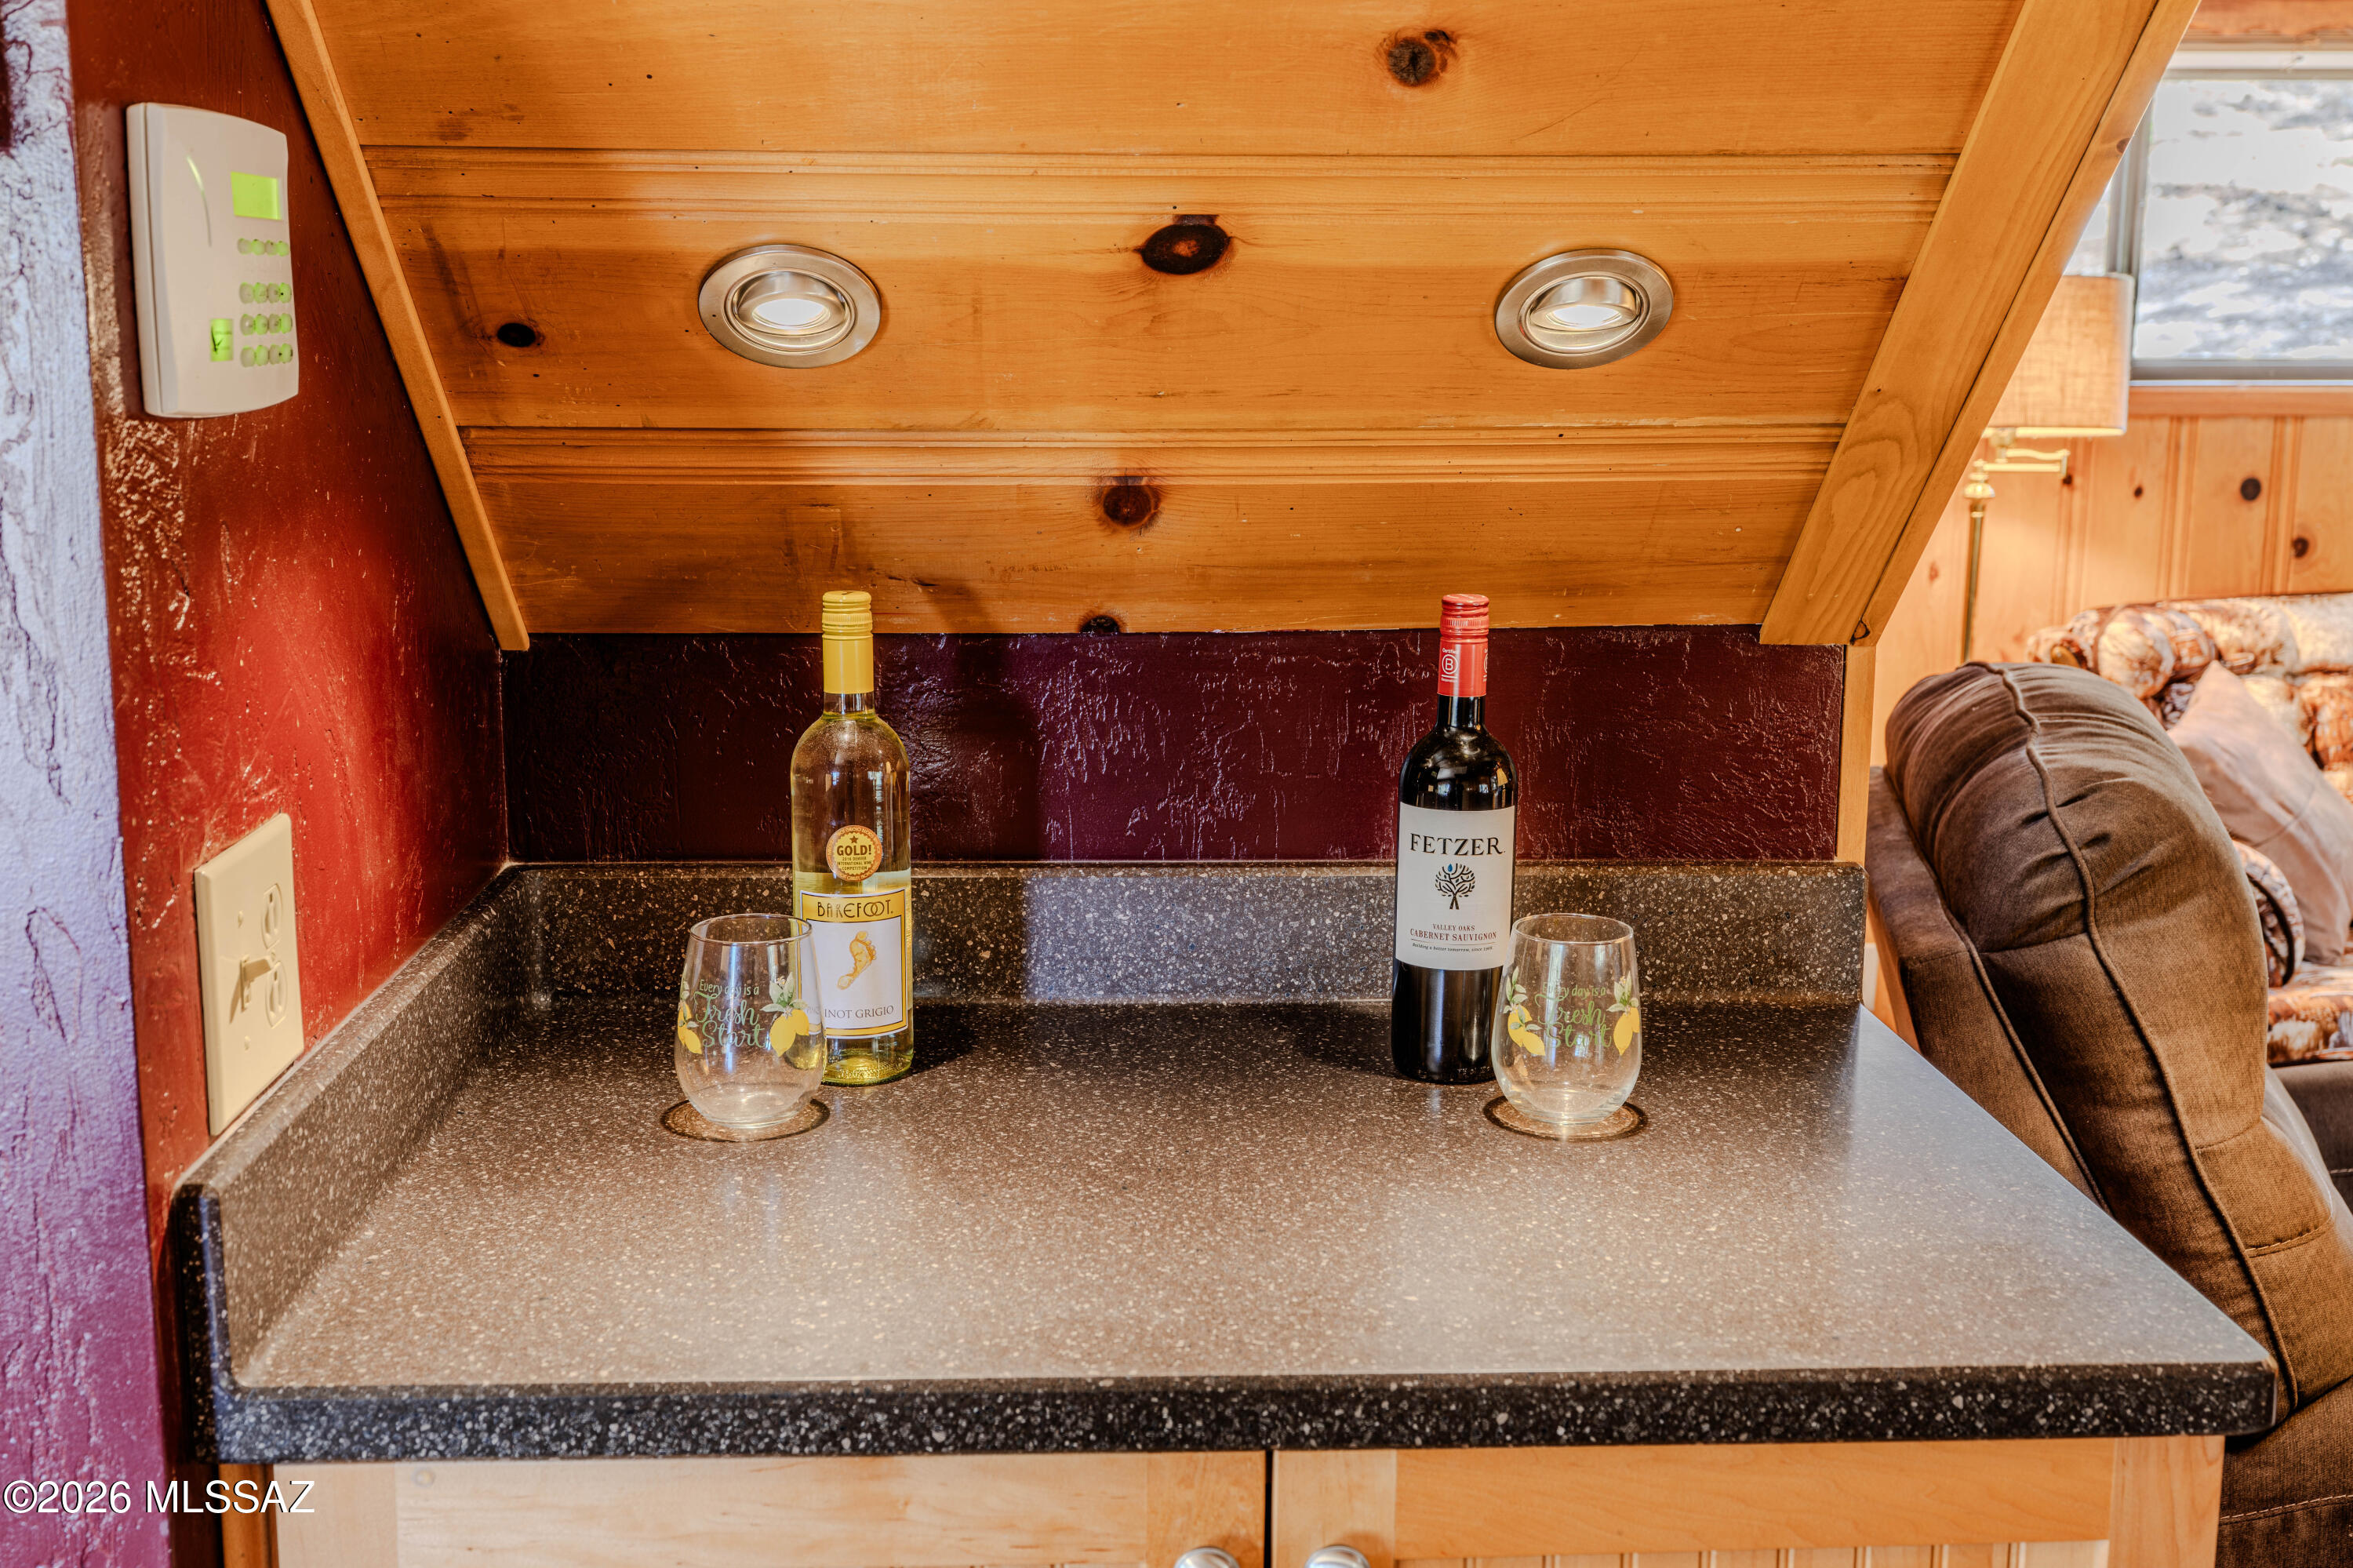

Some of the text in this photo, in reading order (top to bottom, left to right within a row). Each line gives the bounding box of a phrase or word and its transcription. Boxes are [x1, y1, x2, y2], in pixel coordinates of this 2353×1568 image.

[1446, 658, 1453, 671] B
[837, 845, 871, 856] GOLD!
[1410, 833, 1503, 856] FETZER
[817, 900, 891, 919] BAREFOOT
[1410, 929, 1497, 941] CABERNET SAUVIGNON
[700, 979, 759, 998] Every dy is a
[1572, 984, 1589, 1000] day
[1592, 985, 1599, 996] is
[1601, 987, 1606, 996] a
[694, 991, 759, 1026] Fresh
[824, 1009, 853, 1019] INOT
[855, 1005, 894, 1019] GRIGIO
[1535, 994, 1606, 1026] Fresh
[703, 1020, 766, 1048] Start
[1546, 1022, 1612, 1048] Start
